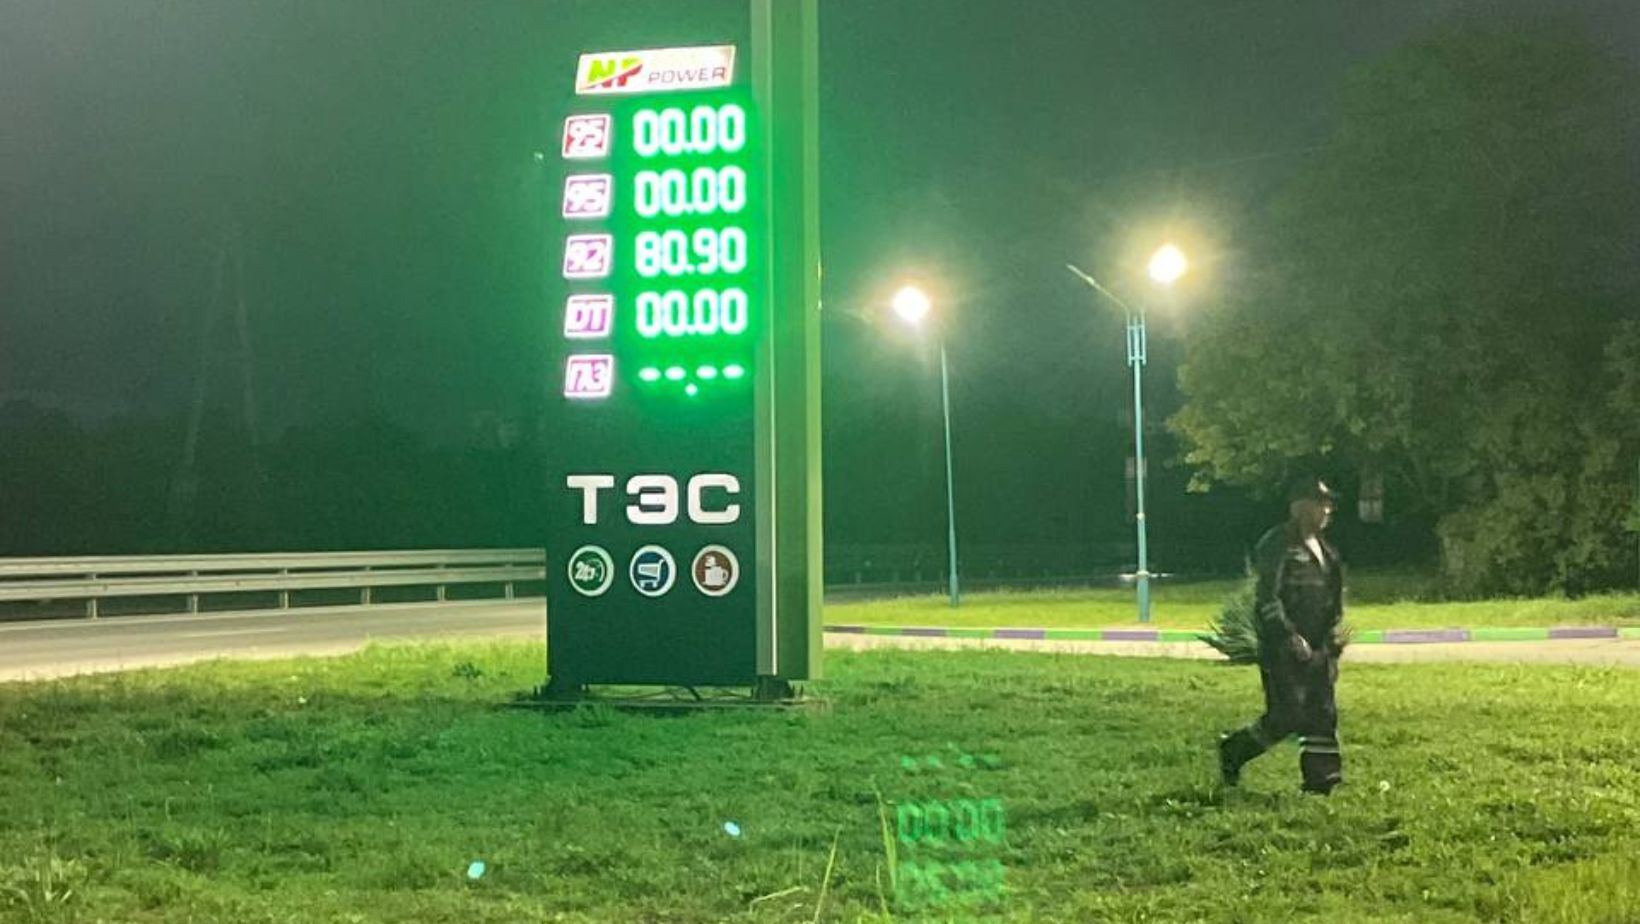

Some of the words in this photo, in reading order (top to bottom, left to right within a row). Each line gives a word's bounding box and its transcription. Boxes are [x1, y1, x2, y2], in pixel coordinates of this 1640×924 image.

[648, 67, 727, 84] POWER
[568, 118, 605, 152] 95
[633, 104, 746, 157] 00.00
[568, 181, 605, 213] 95
[634, 165, 747, 218] 00.00
[567, 241, 605, 272] 92
[635, 226, 748, 278] 80.90
[636, 287, 748, 339] 00.00
[566, 474, 741, 525] ТЭС
